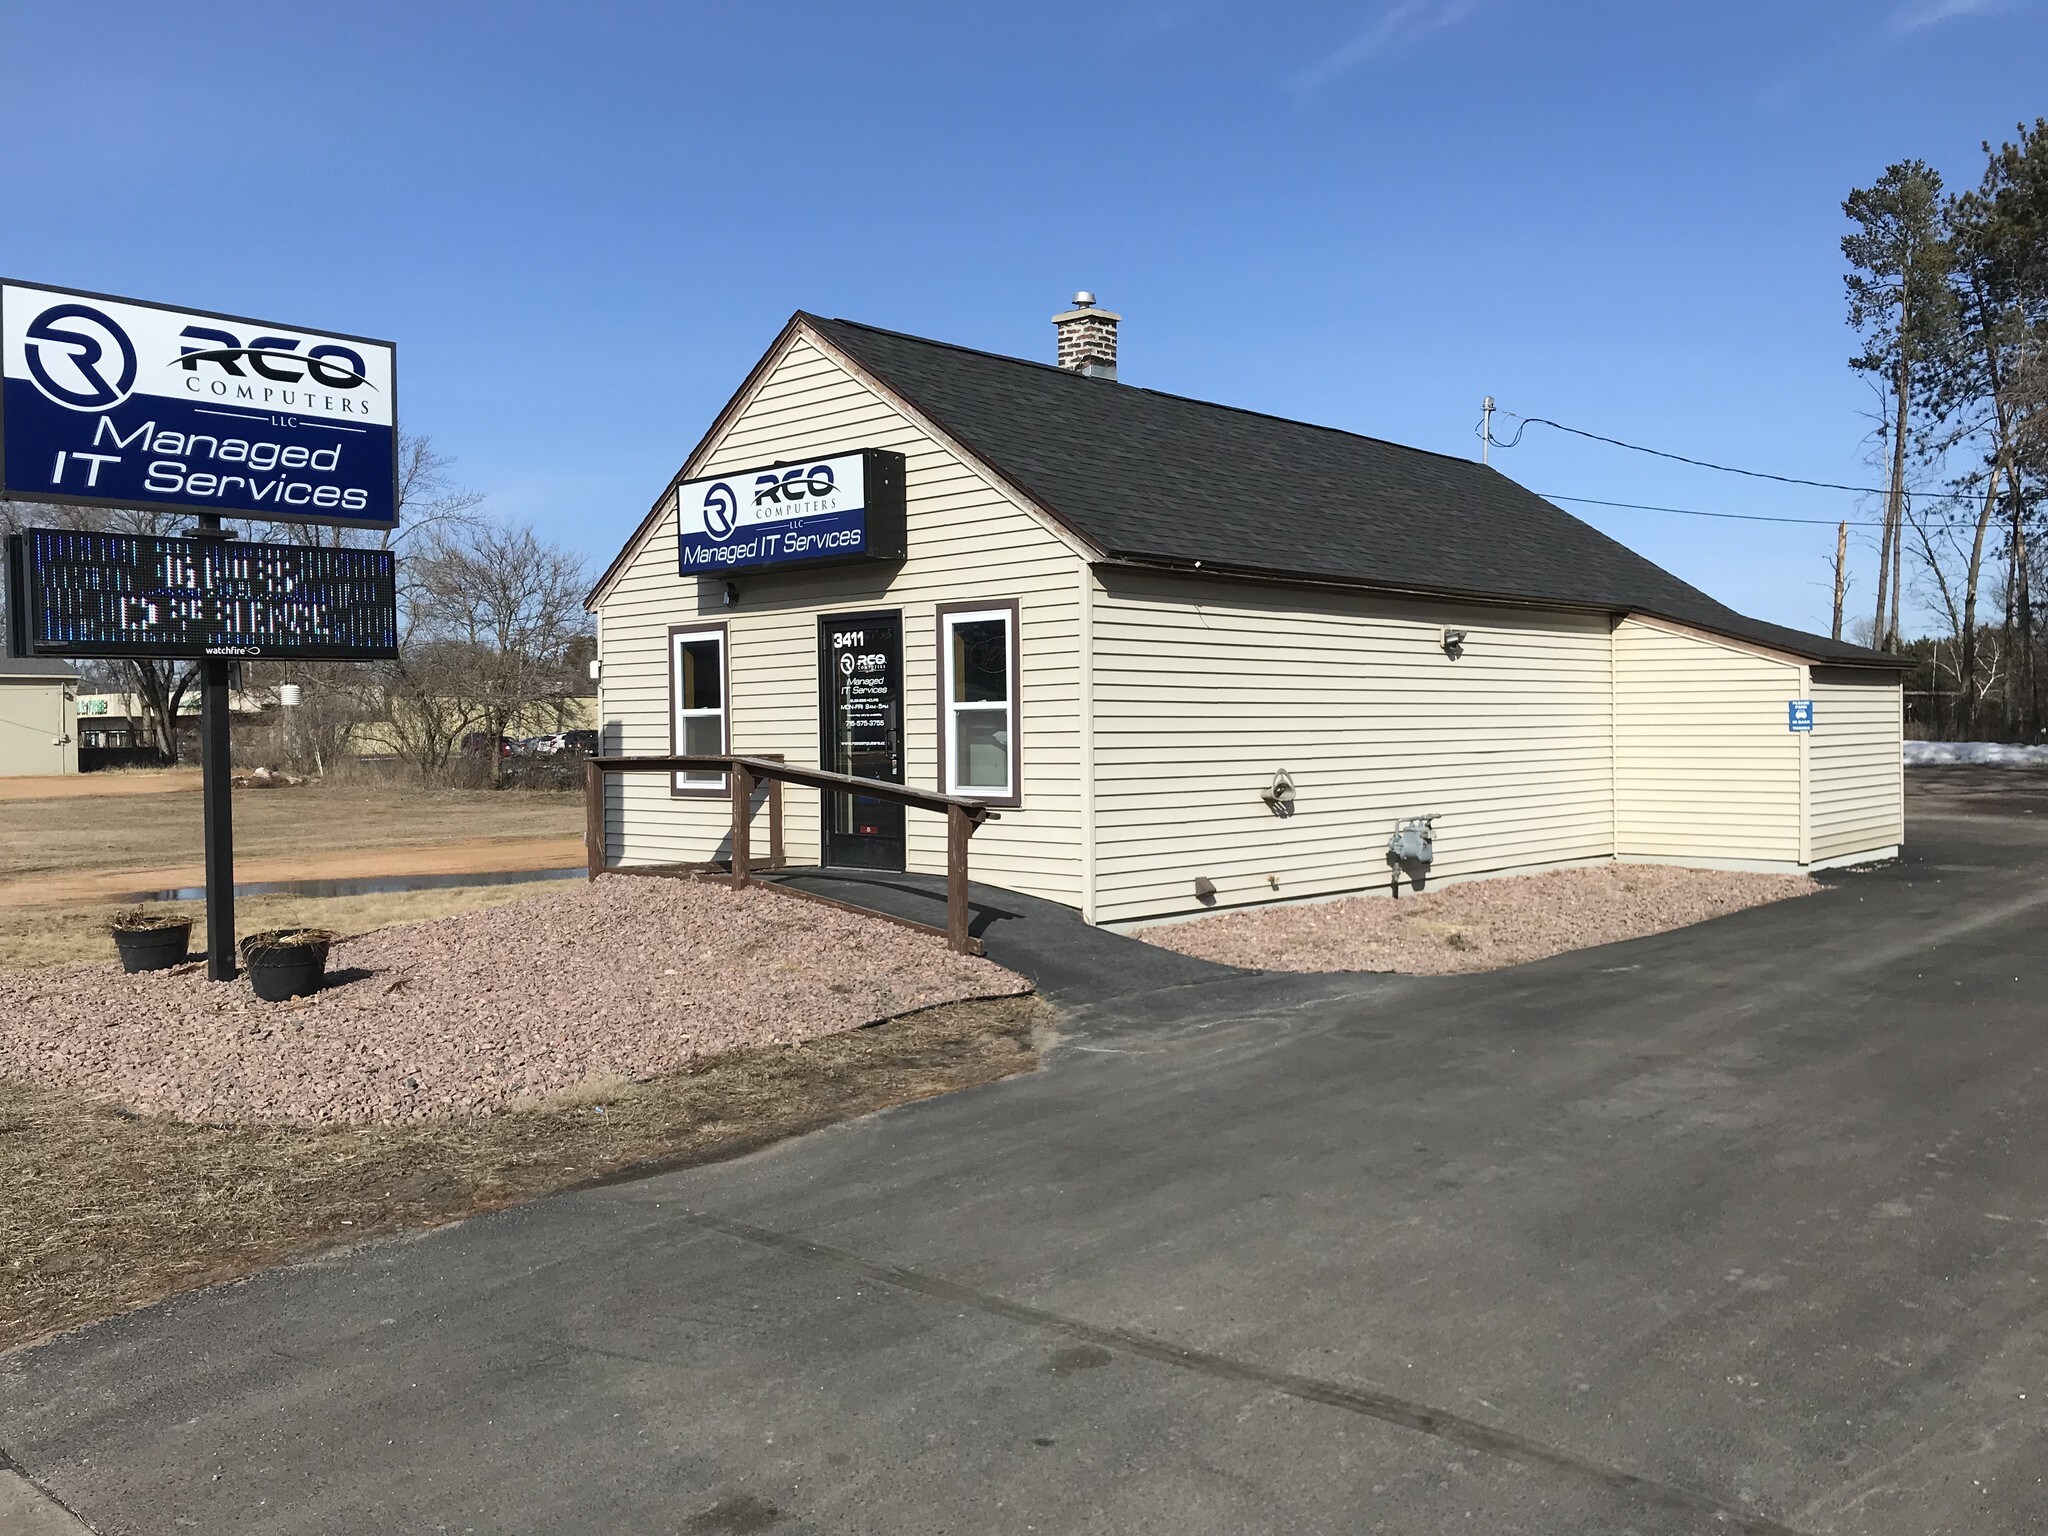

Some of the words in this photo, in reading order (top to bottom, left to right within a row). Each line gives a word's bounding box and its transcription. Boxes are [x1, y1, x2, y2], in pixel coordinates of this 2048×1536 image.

[179, 325, 366, 389] RCO
[186, 376, 370, 415] COMPUTERS
[271, 415, 298, 428] LLC
[93, 415, 342, 472] Managed
[50, 450, 122, 487] IT
[144, 461, 368, 510] Services
[754, 464, 835, 507] RCO
[755, 498, 836, 519] COMPUTERS
[789, 520, 804, 530] LLC
[683, 537, 757, 565] Managed
[760, 534, 781, 557] IT
[783, 528, 862, 553] Services
[833, 631, 864, 649] 3411
[205, 646, 246, 655] watchfire
[857, 653, 886, 666] RCO
[841, 686, 851, 695] IT
[852, 685, 888, 695] Services
[846, 676, 885, 686] Managed
